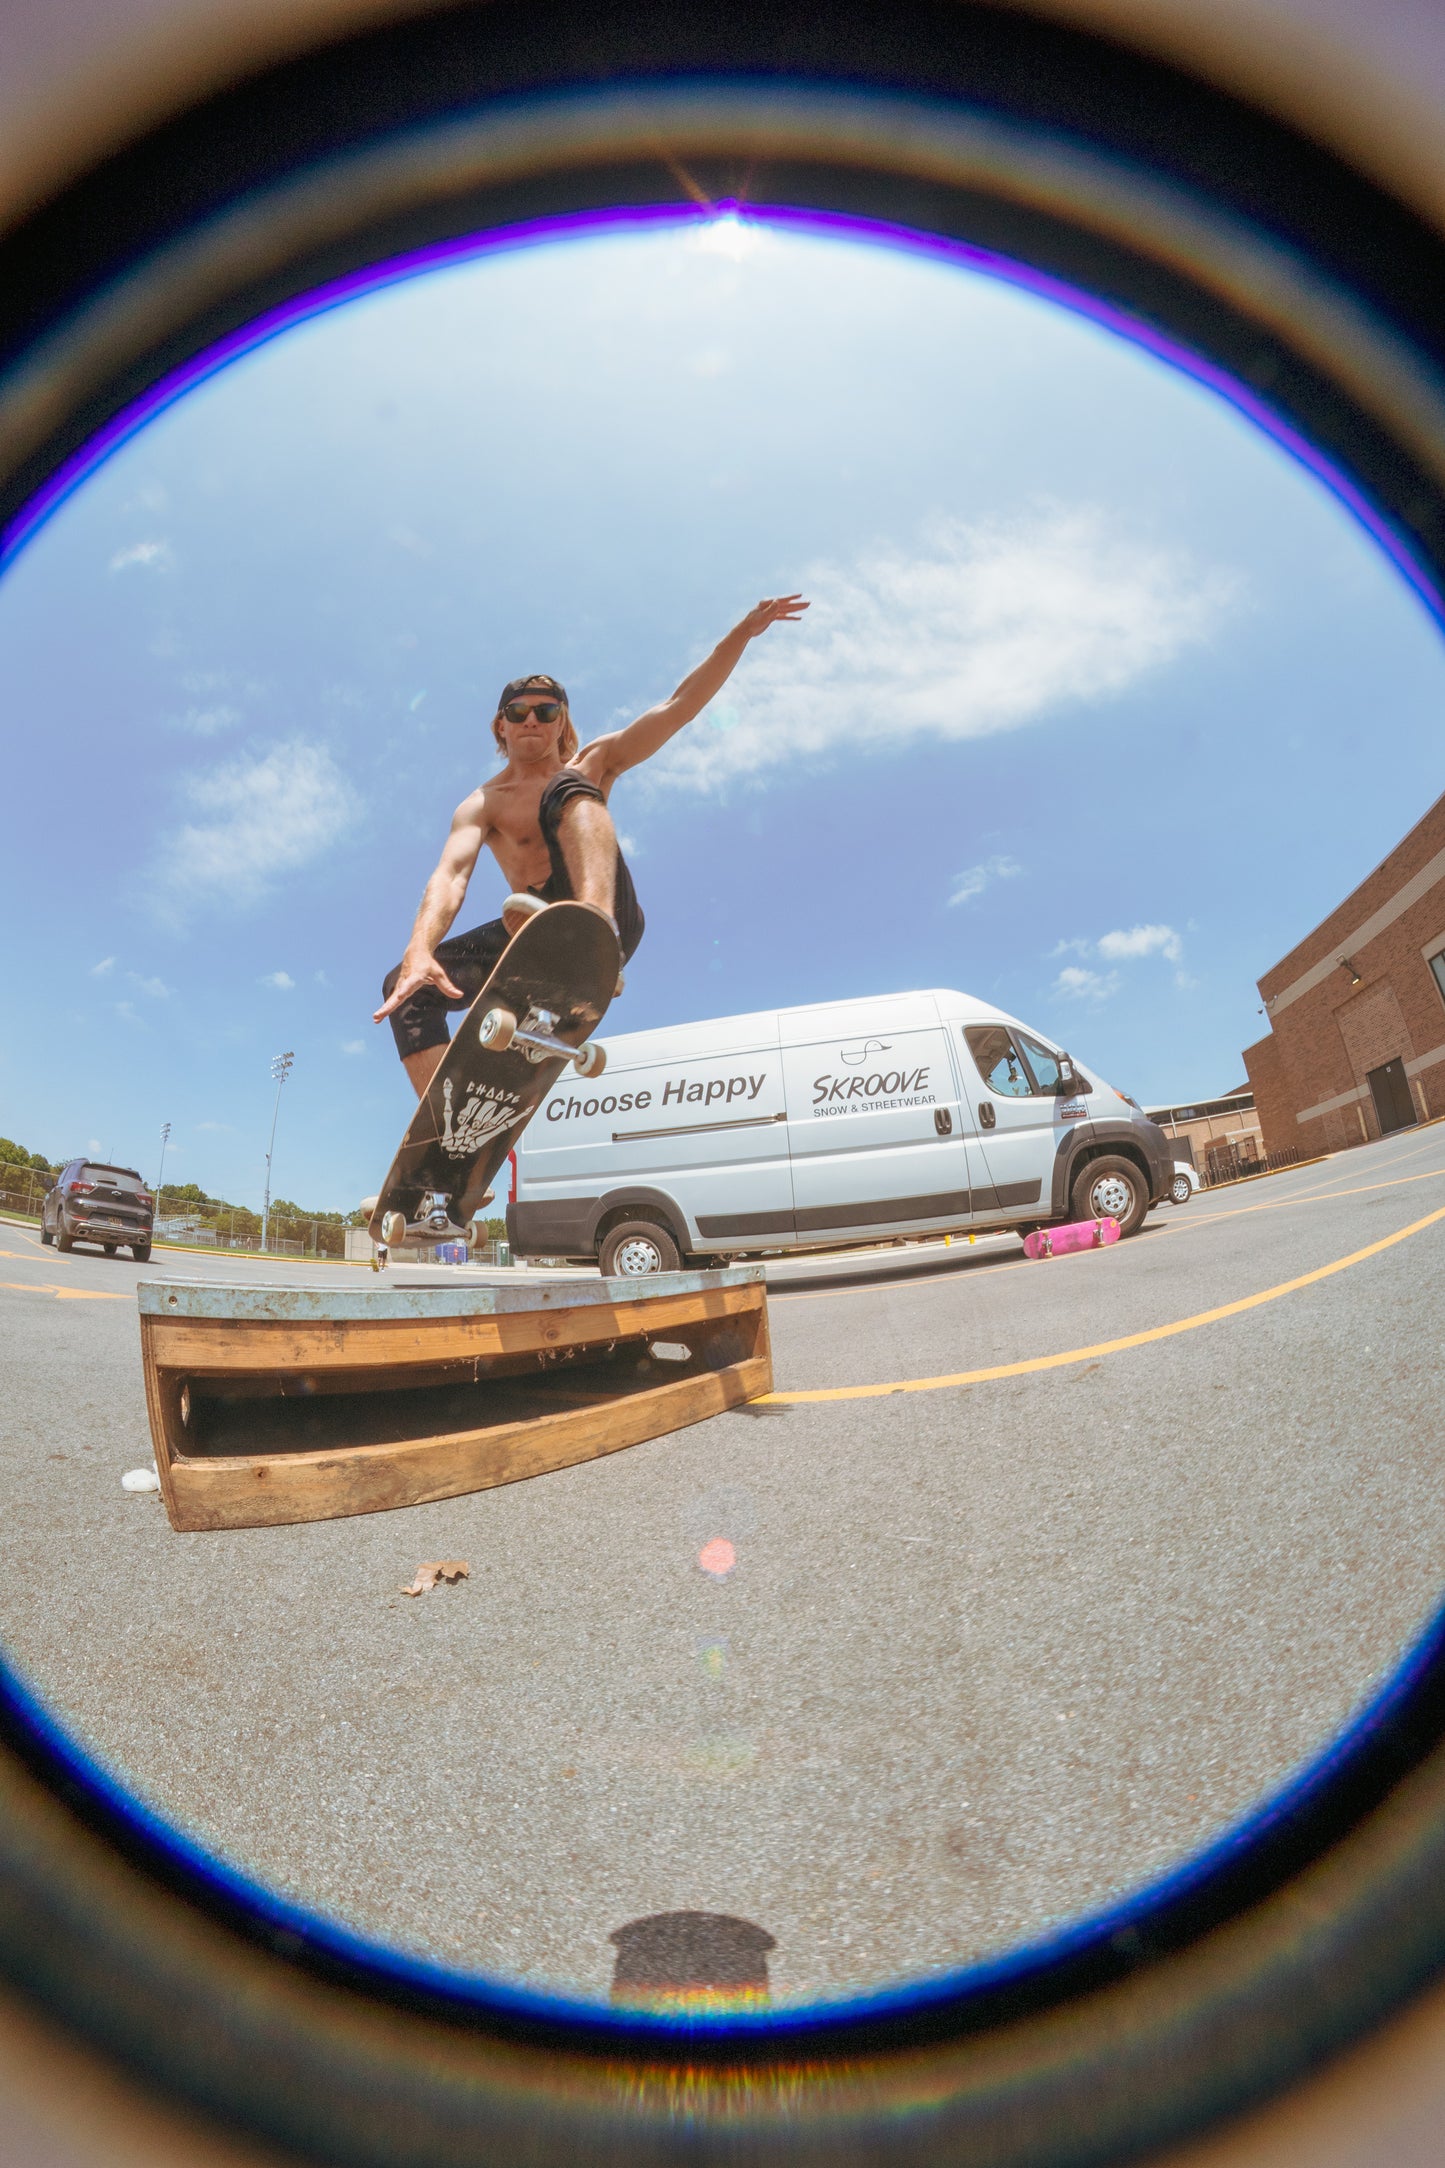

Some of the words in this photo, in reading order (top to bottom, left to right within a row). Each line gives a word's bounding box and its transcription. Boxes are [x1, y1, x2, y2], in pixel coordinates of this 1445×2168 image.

[546, 1091, 652, 1122] Choose
[662, 1073, 767, 1106] Happy
[812, 1067, 930, 1104] SKROOVE
[813, 1105, 848, 1117] SNOW
[850, 1104, 858, 1113] &
[861, 1095, 936, 1112] STREETWEAR
